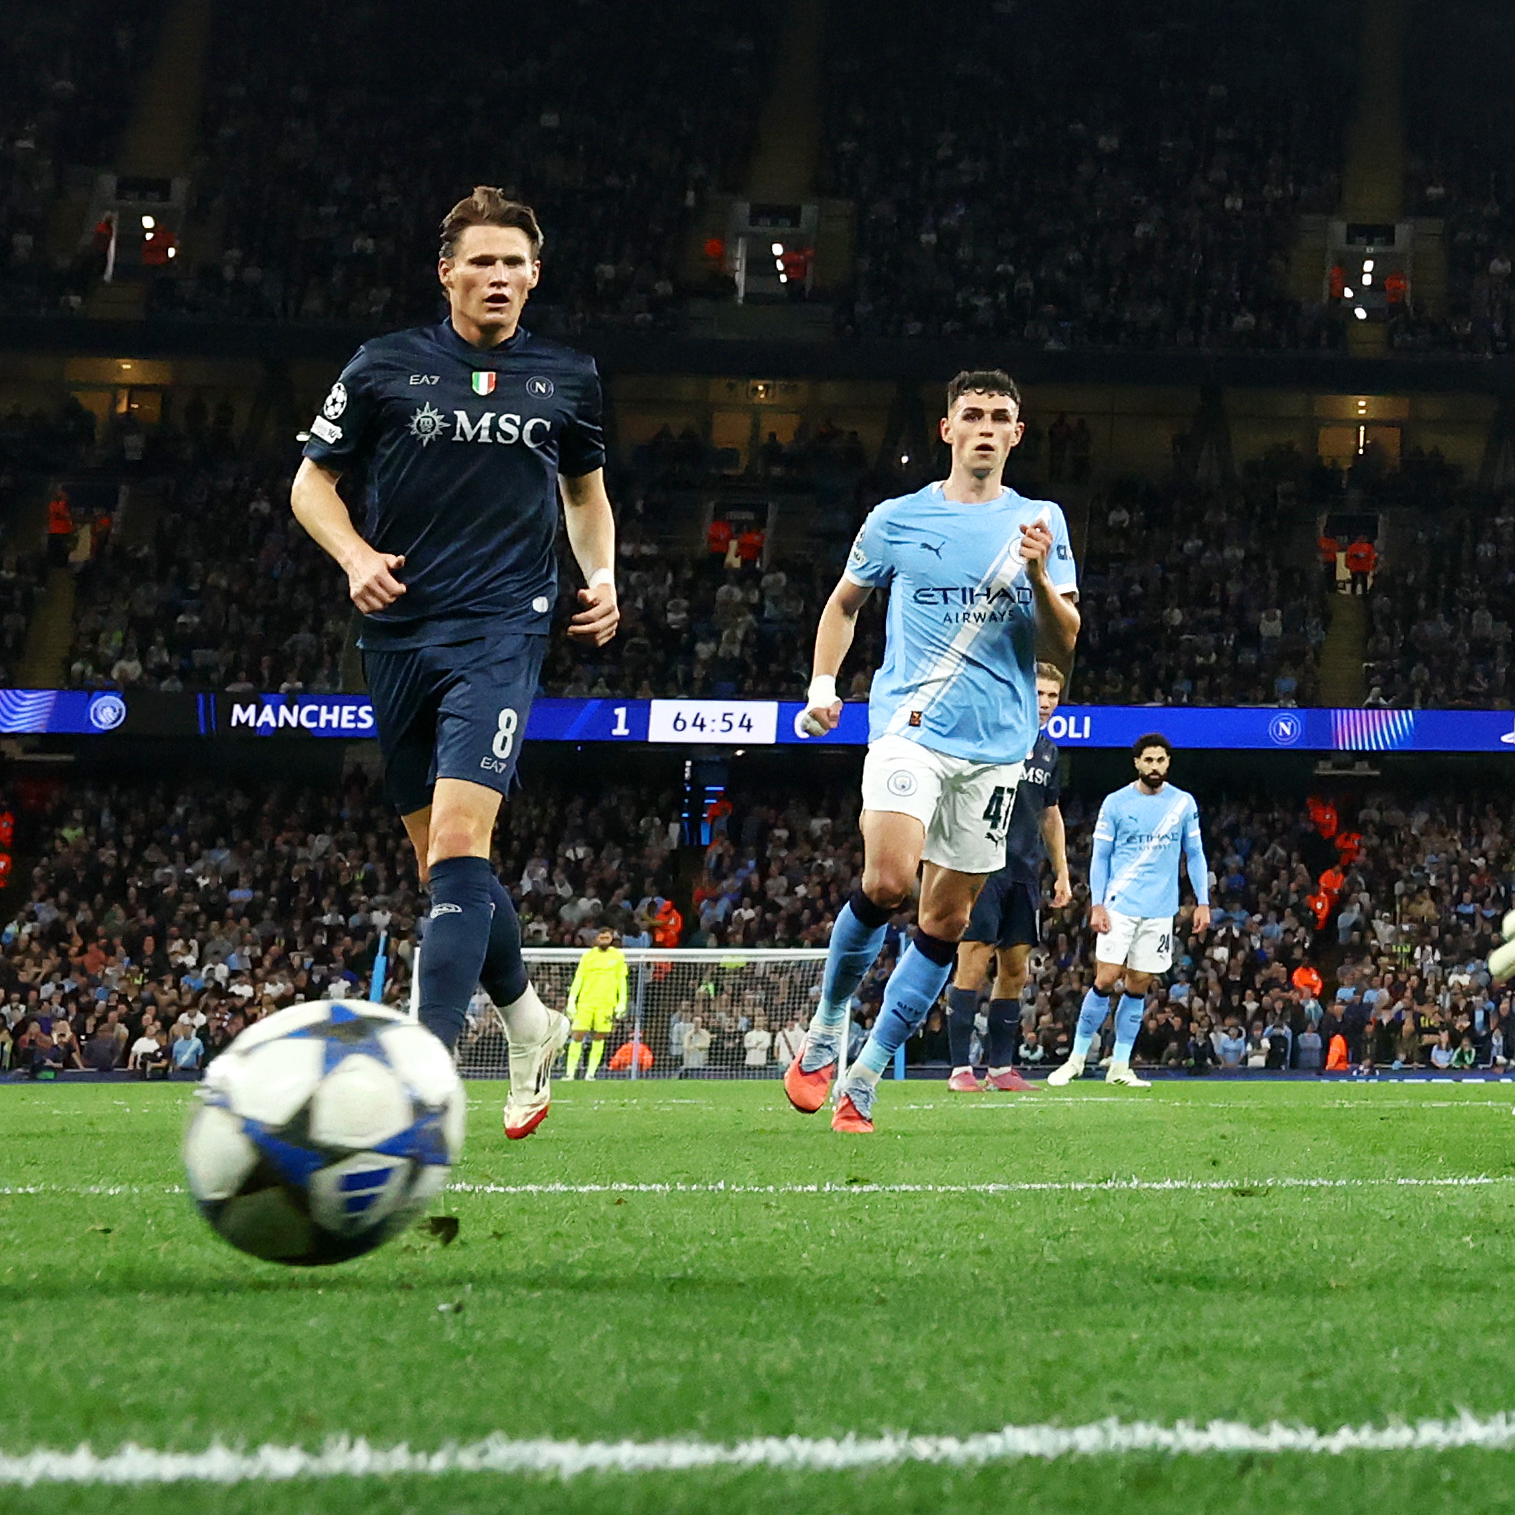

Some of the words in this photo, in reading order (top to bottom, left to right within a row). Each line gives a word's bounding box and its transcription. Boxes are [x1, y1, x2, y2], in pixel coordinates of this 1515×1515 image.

[409, 374, 441, 385] EA7
[451, 410, 551, 449] MSC
[913, 587, 1033, 606] ETIHAD
[943, 609, 1015, 624] AIRWAYS
[231, 703, 374, 730] MANCHES
[611, 707, 630, 735] 1
[672, 711, 754, 734] 64:54
[1040, 715, 1091, 739] OLI
[492, 708, 518, 760] 8
[481, 756, 508, 775] EA7
[1156, 934, 1170, 954] 24
